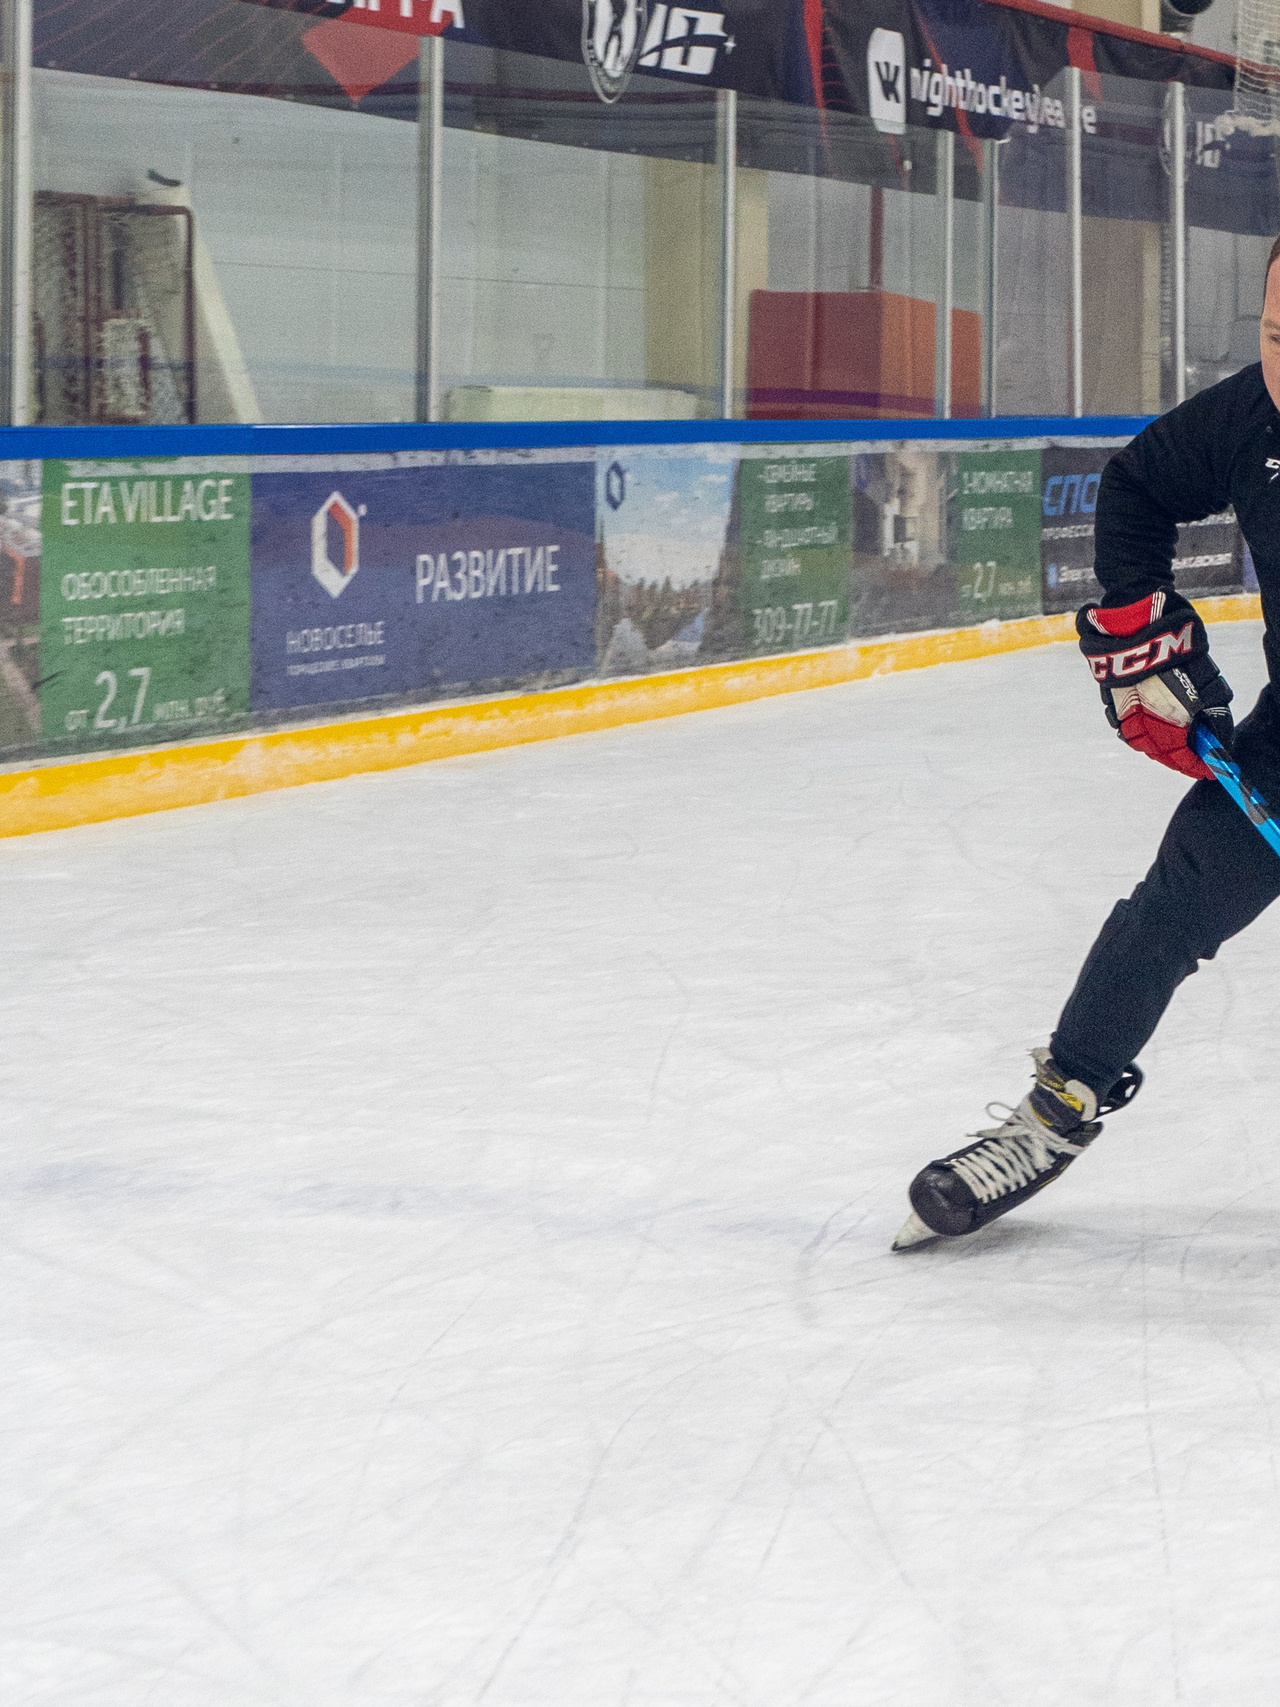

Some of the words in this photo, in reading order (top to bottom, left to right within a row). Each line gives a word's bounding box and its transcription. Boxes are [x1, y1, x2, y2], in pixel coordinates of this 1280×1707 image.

[61, 480, 118, 526] ETA
[119, 477, 235, 523] VILLAGE
[415, 543, 561, 605] РАЗВИТИЕ
[1086, 622, 1194, 682] CCM
[94, 666, 151, 734] 2,7
